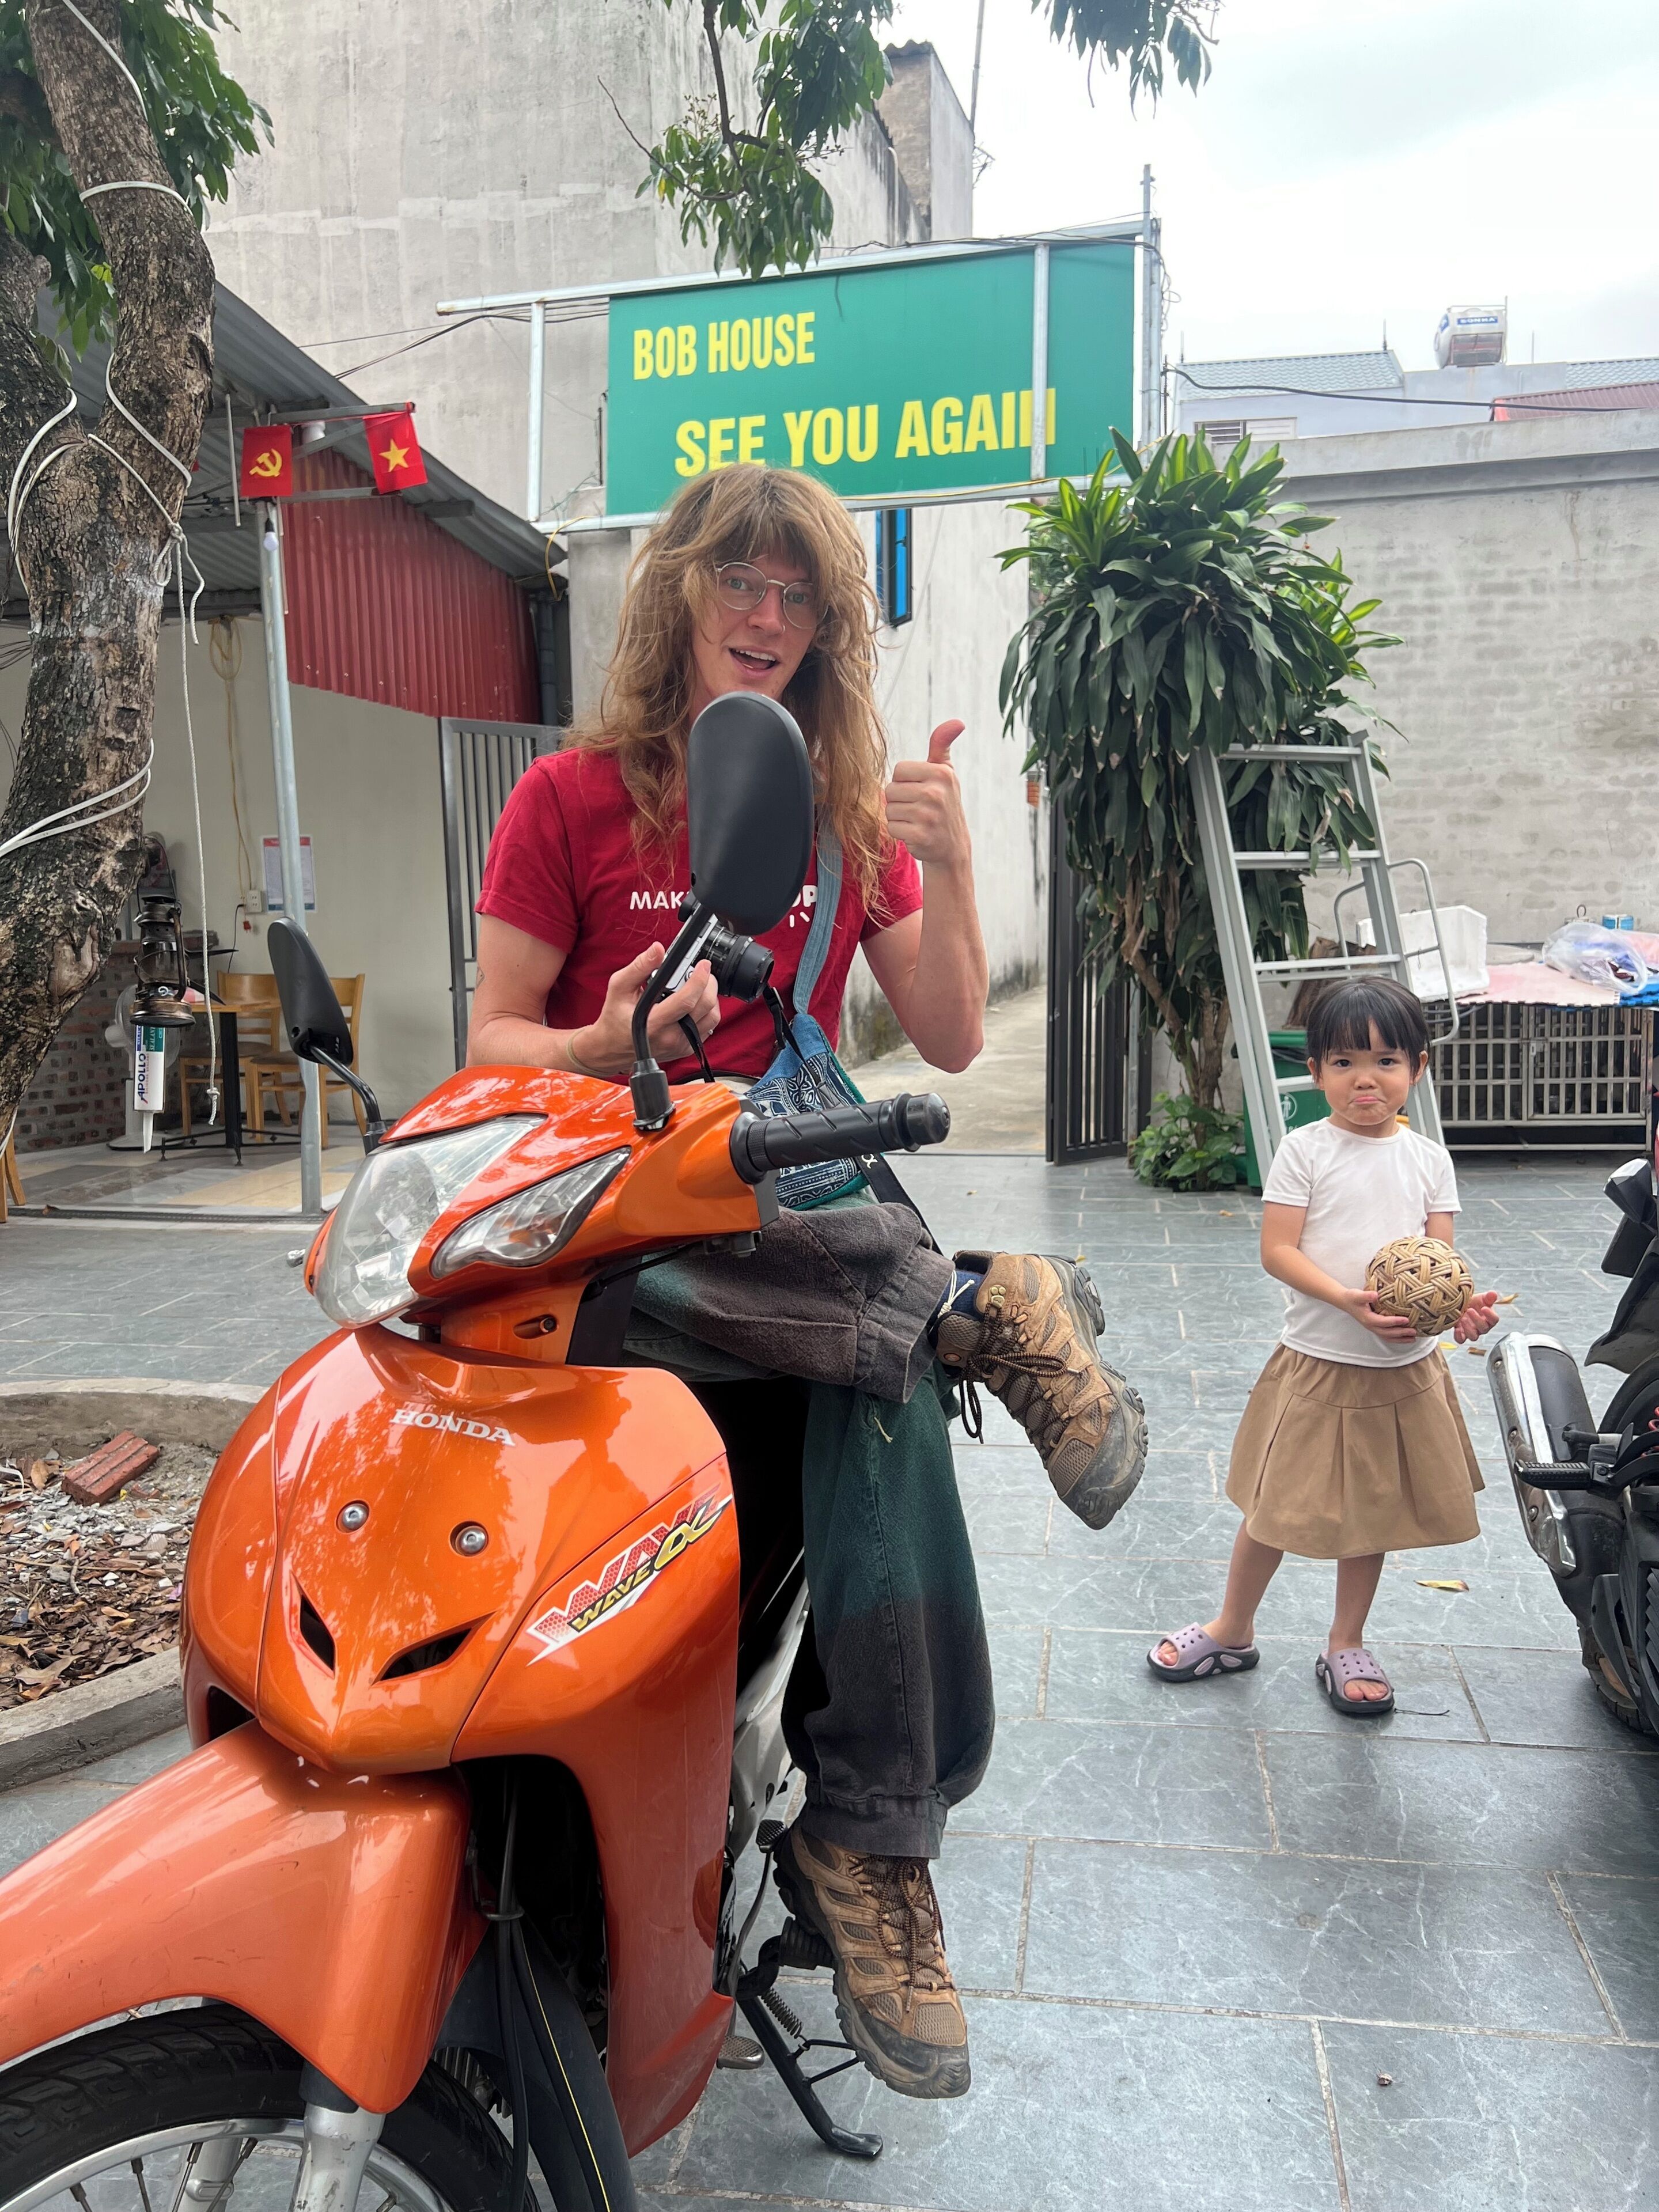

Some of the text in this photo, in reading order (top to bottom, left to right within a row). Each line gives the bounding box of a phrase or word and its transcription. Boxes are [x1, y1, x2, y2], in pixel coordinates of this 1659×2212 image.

[634, 312, 815, 380] BOB HOUSE
[675, 415, 766, 477] SEE
[782, 404, 878, 468] YOU
[630, 891, 691, 910] MAK
[137, 1054, 148, 1104] APOLLO
[389, 1408, 516, 1446] HONDA
